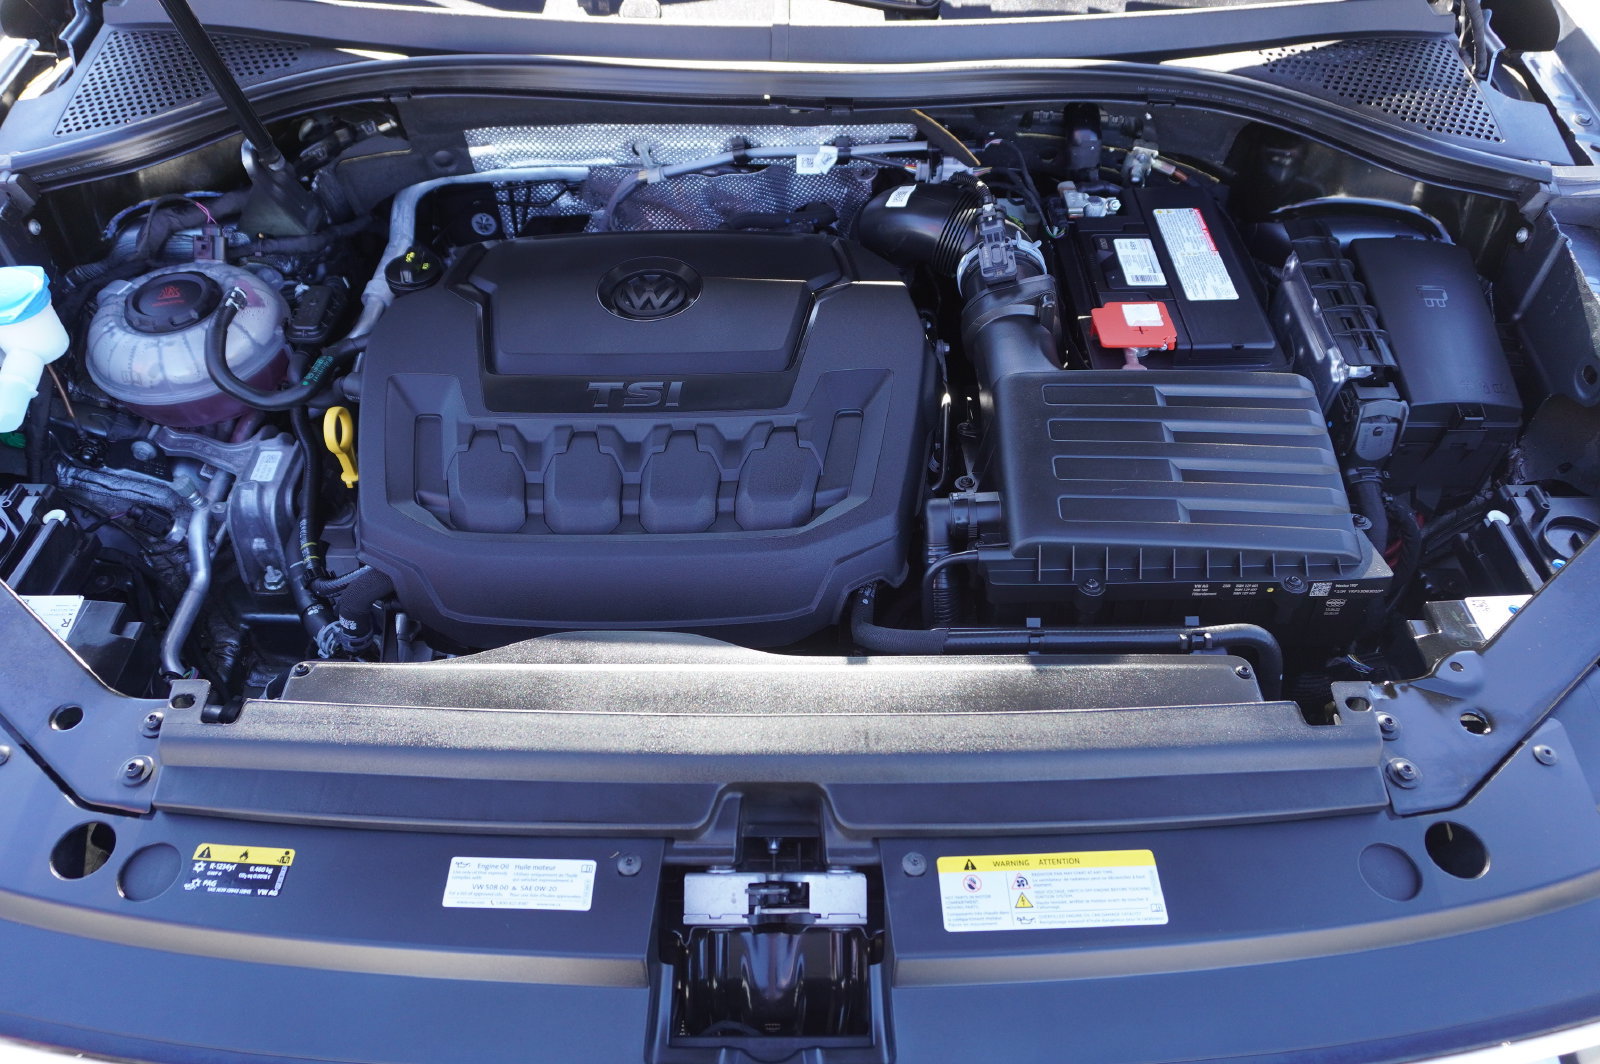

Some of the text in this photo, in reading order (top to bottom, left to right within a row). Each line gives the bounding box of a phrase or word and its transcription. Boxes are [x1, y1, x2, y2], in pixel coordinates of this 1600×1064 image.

[587, 381, 686, 408] TSI
[210, 863, 237, 872] R-1234yf
[477, 863, 498, 871] Engine
[992, 857, 1081, 868] WARNING ATTENTION
